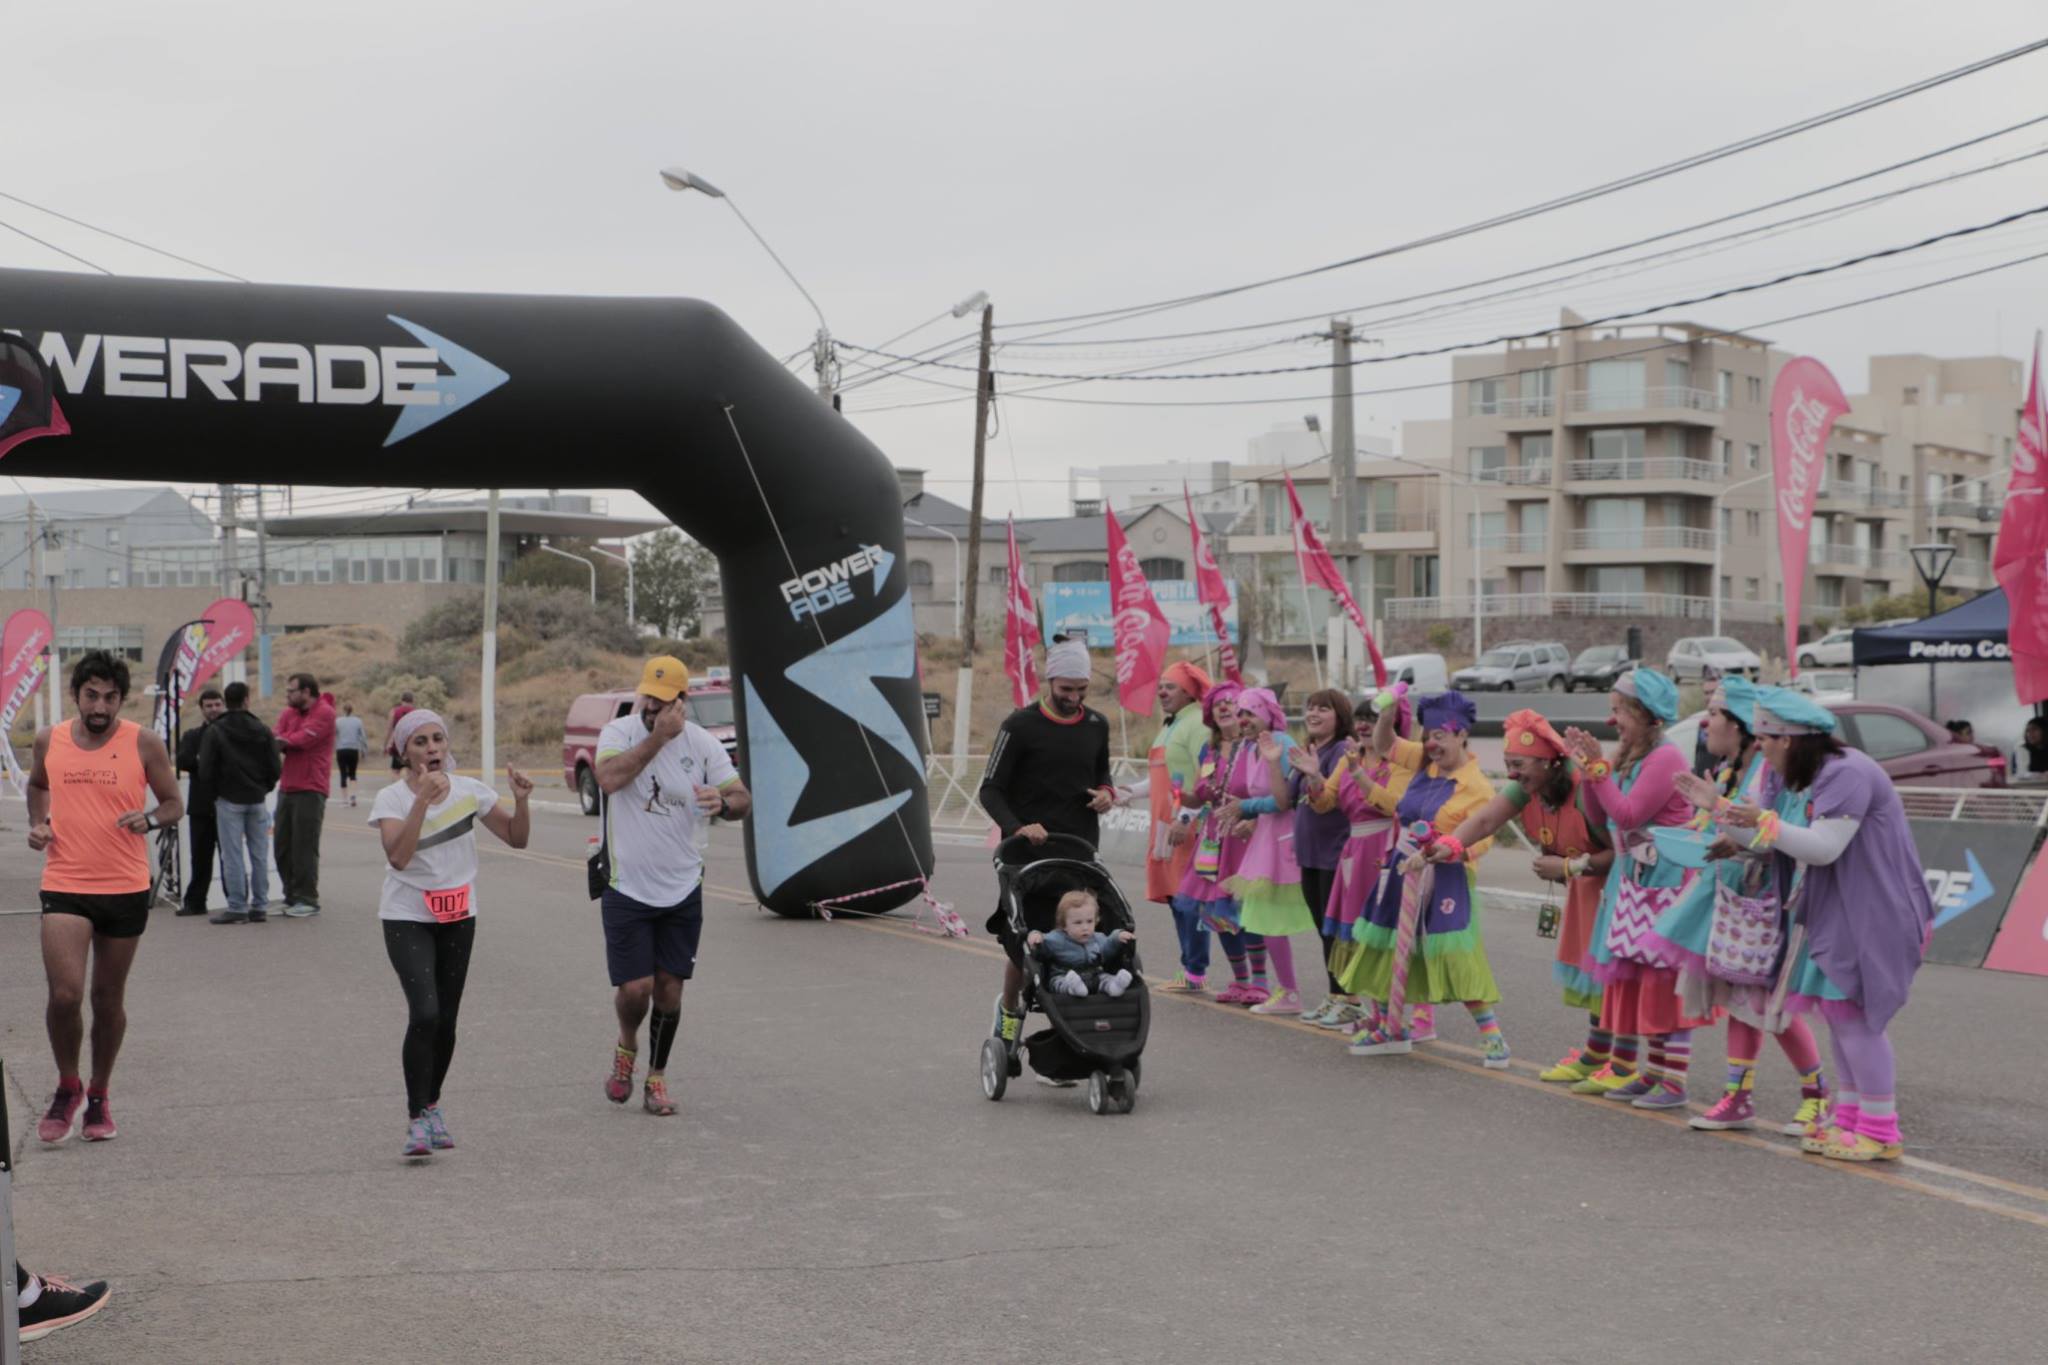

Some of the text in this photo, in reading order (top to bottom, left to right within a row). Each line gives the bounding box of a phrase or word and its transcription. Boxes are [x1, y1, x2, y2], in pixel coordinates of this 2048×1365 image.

[779, 544, 884, 602] POWER
[789, 581, 855, 622] ADE
[1909, 641, 1973, 658] Pedro
[431, 892, 465, 913] 007
